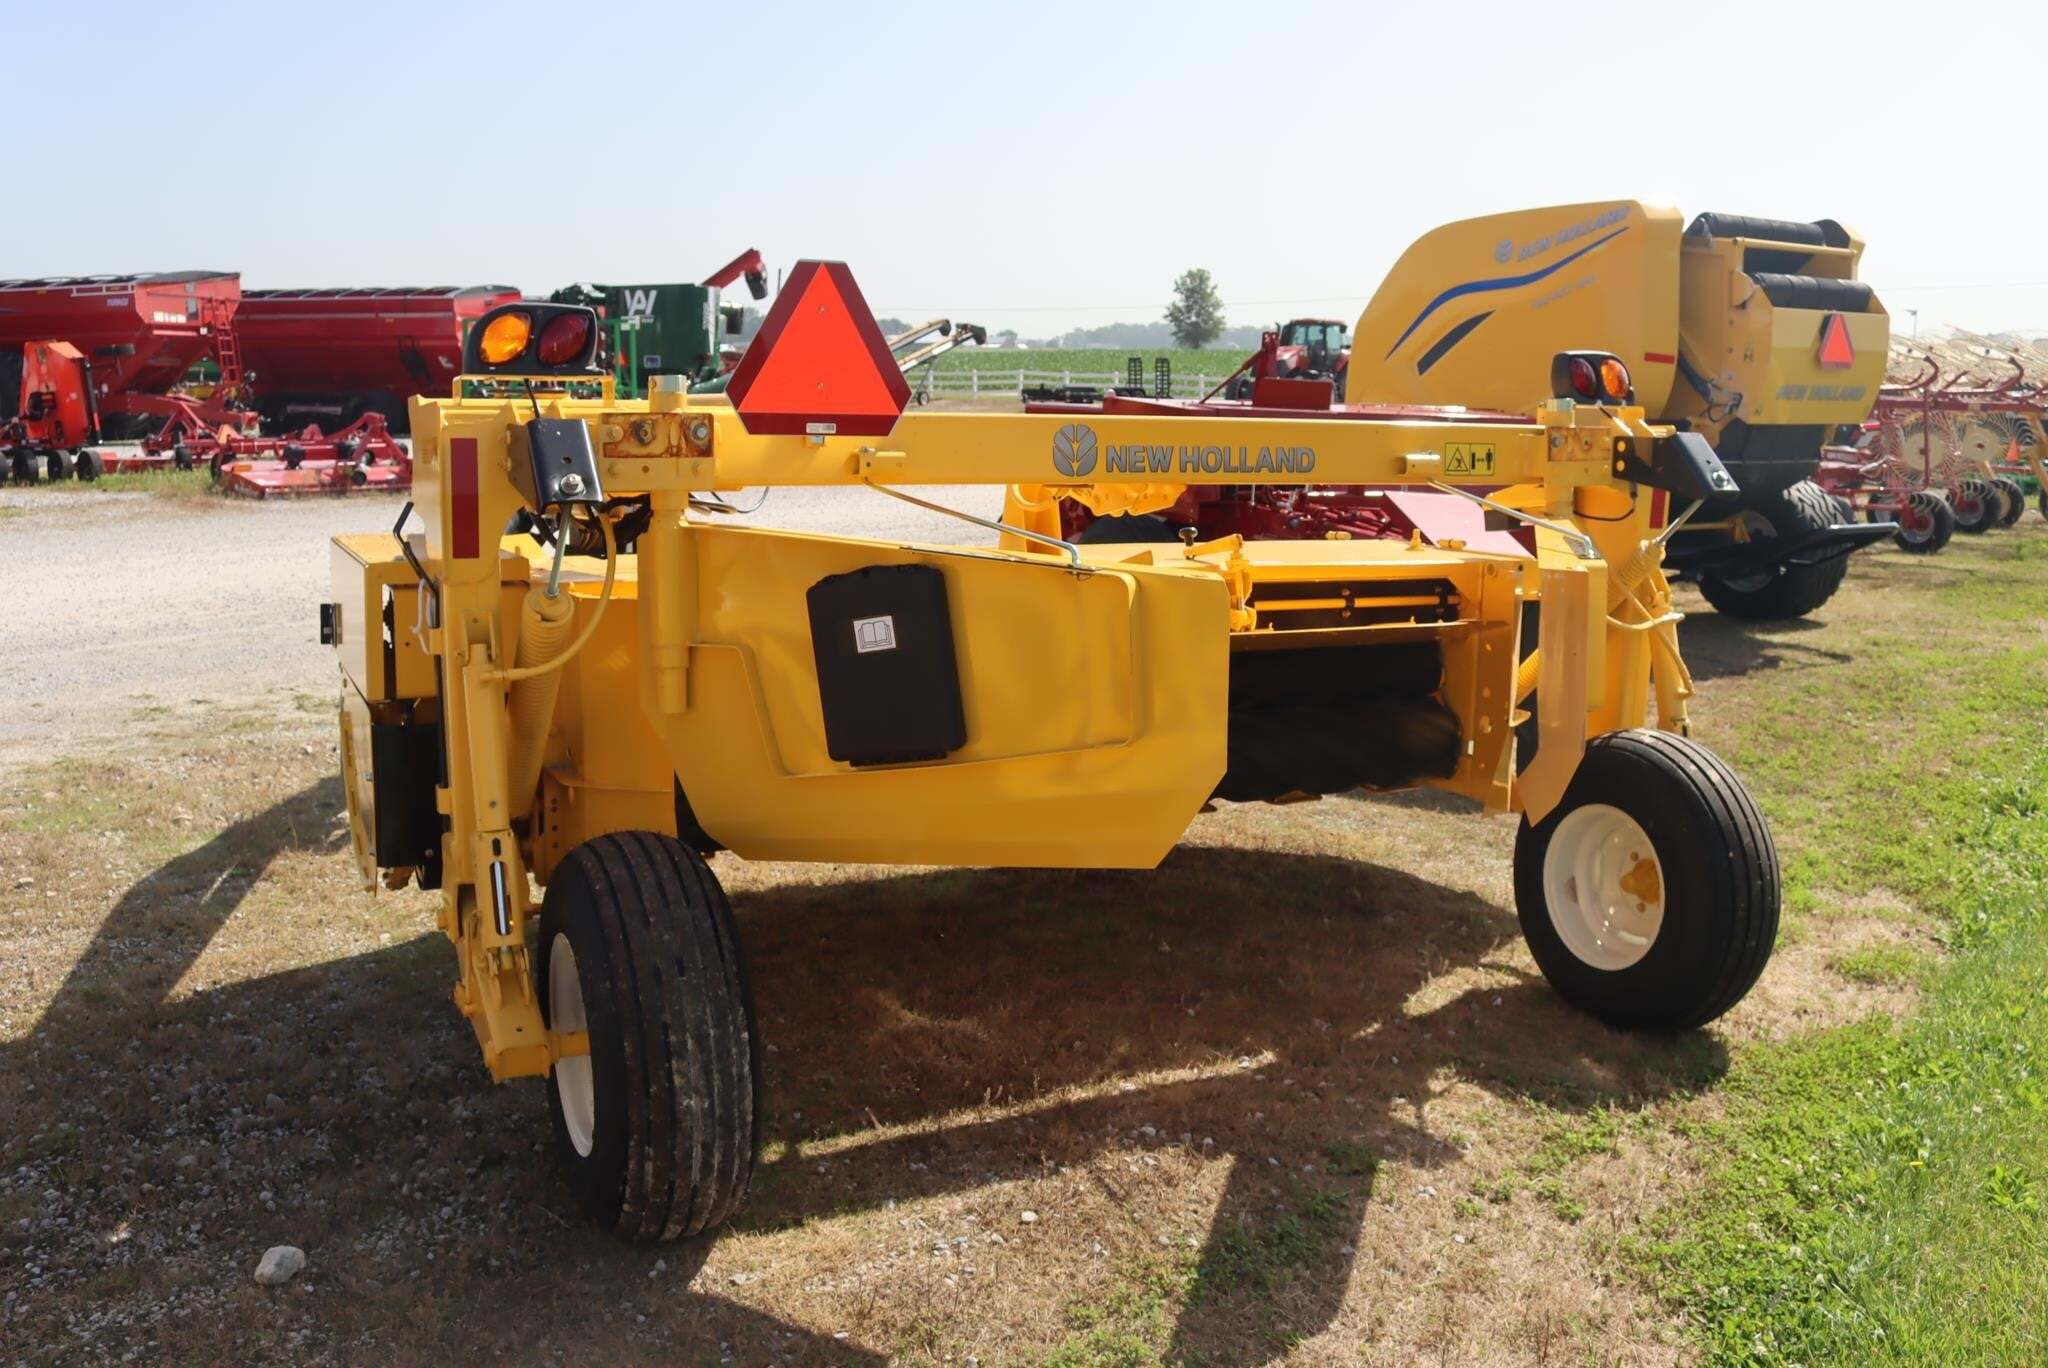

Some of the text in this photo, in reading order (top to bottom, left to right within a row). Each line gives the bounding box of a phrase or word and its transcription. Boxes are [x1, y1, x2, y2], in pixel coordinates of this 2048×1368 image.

[1776, 384, 1867, 401] NEW HOLLAND
[1105, 445, 1316, 474] NEW HOLLAND
